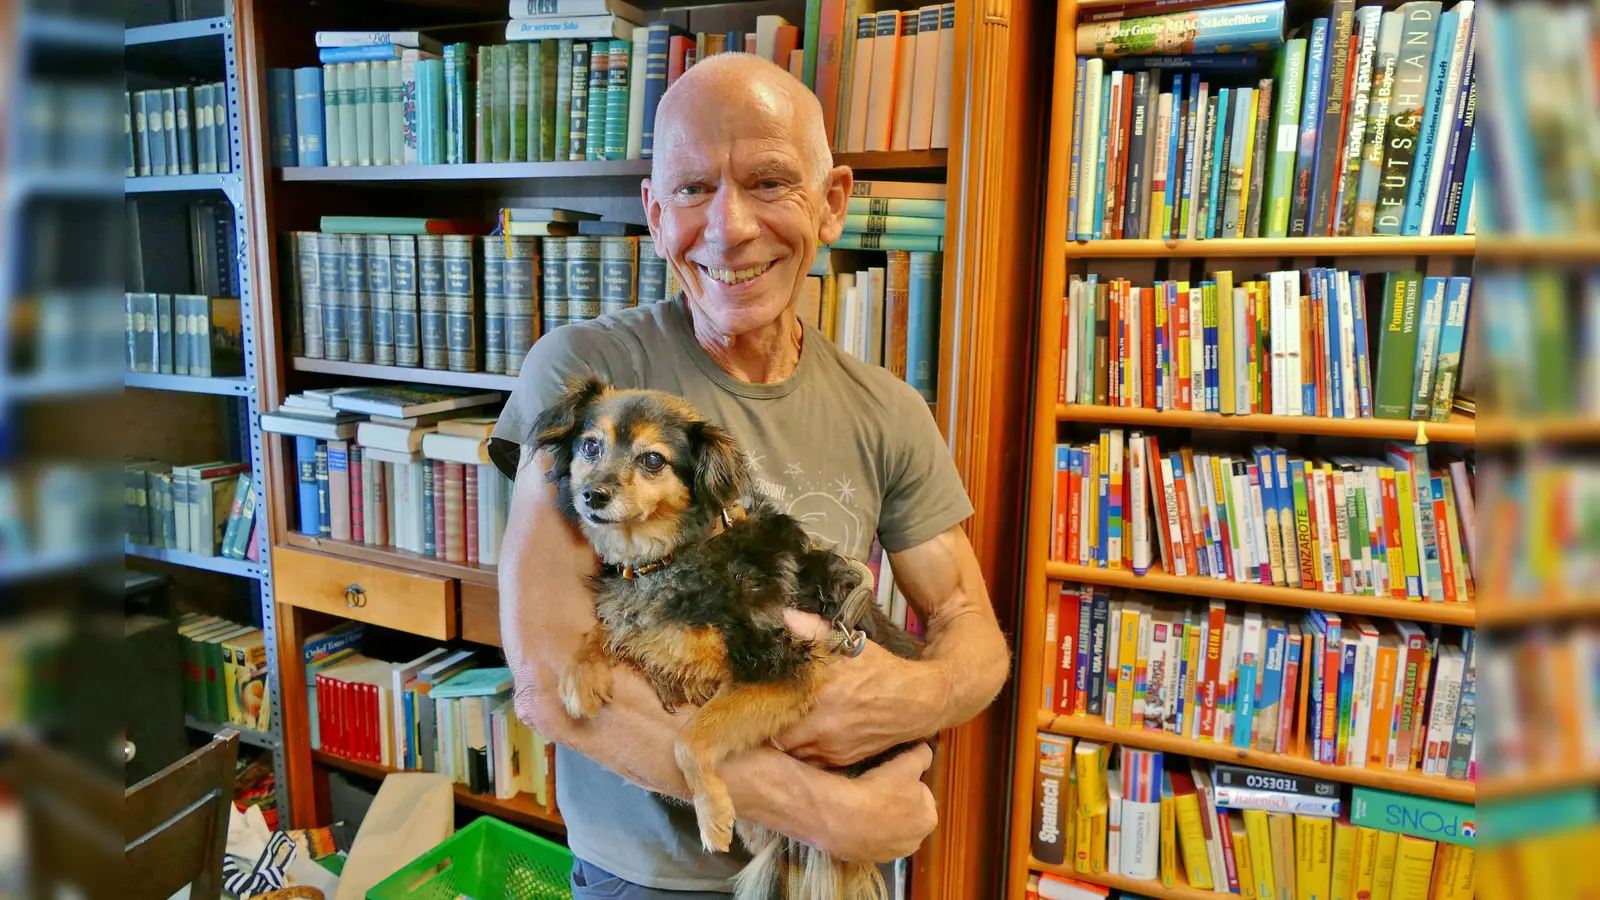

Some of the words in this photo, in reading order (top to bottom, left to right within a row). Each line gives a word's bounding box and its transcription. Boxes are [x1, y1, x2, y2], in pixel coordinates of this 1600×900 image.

[1111, 27, 1131, 38] Der
[1132, 24, 1166, 36] Große
[1199, 14, 1269, 30] Städteführer
[1313, 26, 1325, 61] ALPEN
[1334, 11, 1353, 47] Eisenbahn
[1356, 10, 1381, 91] Wunderwelt
[1284, 51, 1300, 116] Alpenhotels
[1312, 63, 1322, 78] die
[1376, 58, 1395, 97] Bayern
[1437, 60, 1448, 79] Luft
[1309, 80, 1320, 100] über
[1433, 97, 1441, 113] aus
[1435, 80, 1443, 95] der
[1457, 91, 1467, 119] MALEDIVEN
[1135, 105, 1144, 135] BERLIN
[1306, 102, 1317, 120] Fuß
[1355, 94, 1371, 118] der
[1380, 9, 1432, 226] DEUTSCHLAND
[1349, 118, 1370, 157] Alpen
[1371, 98, 1389, 162] Freizeitland
[1426, 114, 1437, 144] Küsten
[1185, 142, 1194, 162] Flüssen
[1069, 162, 1078, 199] Mallorca
[1183, 171, 1192, 194] Wandern
[1415, 145, 1433, 208] Jugoslawische
[1389, 279, 1405, 331] Pommern
[1403, 280, 1417, 333] WEGWEISER
[1165, 483, 1179, 525] MENORCA
[1336, 503, 1348, 540] ALGARVE
[1346, 497, 1358, 519] PARIS
[1215, 541, 1224, 572] POLYGLOTT
[1269, 526, 1279, 569] Lanzarote
[1284, 526, 1294, 569] Lanzarote
[1296, 509, 1313, 583] LANZAROTE
[1062, 635, 1073, 669] Mexiko
[1092, 623, 1104, 673] USA/Florida
[1208, 628, 1220, 660] CHINA
[1185, 669, 1195, 703] Südafrika
[1204, 680, 1215, 707] Guide
[1401, 661, 1418, 731] AUSTRALIEN
[1246, 775, 1298, 792] TEDESCO
[1038, 778, 1060, 843] Spanisch
[1386, 805, 1458, 837] PONS
[1134, 811, 1145, 863] FRANZÖSISCH
[1318, 824, 1329, 863] Italienisch
